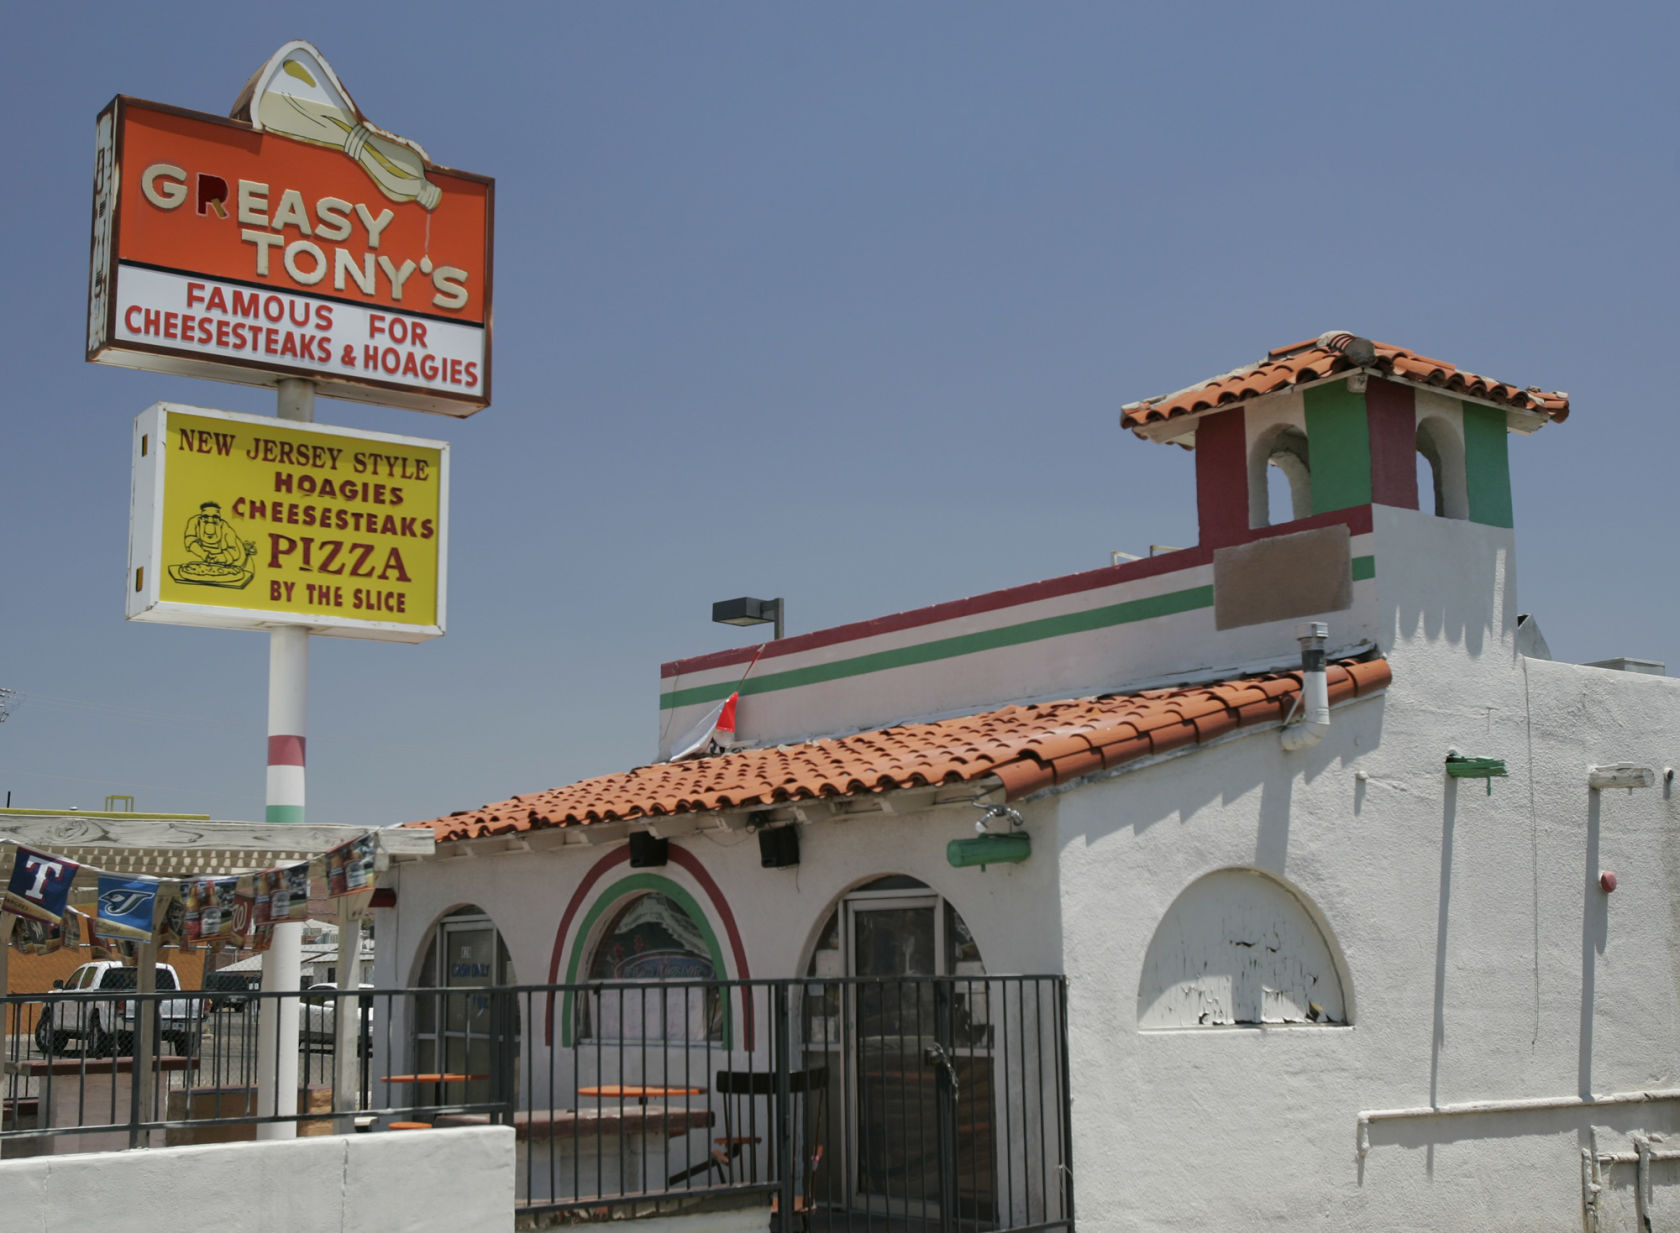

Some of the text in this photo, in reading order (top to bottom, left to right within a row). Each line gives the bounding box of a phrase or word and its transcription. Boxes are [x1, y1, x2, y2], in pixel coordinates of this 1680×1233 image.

[142, 163, 394, 248] GREASY
[241, 229, 469, 310] TONY'S
[186, 282, 427, 348] FAMOUS FOR
[124, 305, 478, 388] CHEESESTEAKS & HOAGIES
[178, 428, 430, 482] NEW JERSEY STYLE
[274, 471, 404, 506] HOAGIES
[232, 496, 434, 540] CHEESESTEAKS
[267, 532, 412, 583] PIZZA
[270, 580, 406, 614] BY THE SLICE
[25, 855, 64, 901] T
